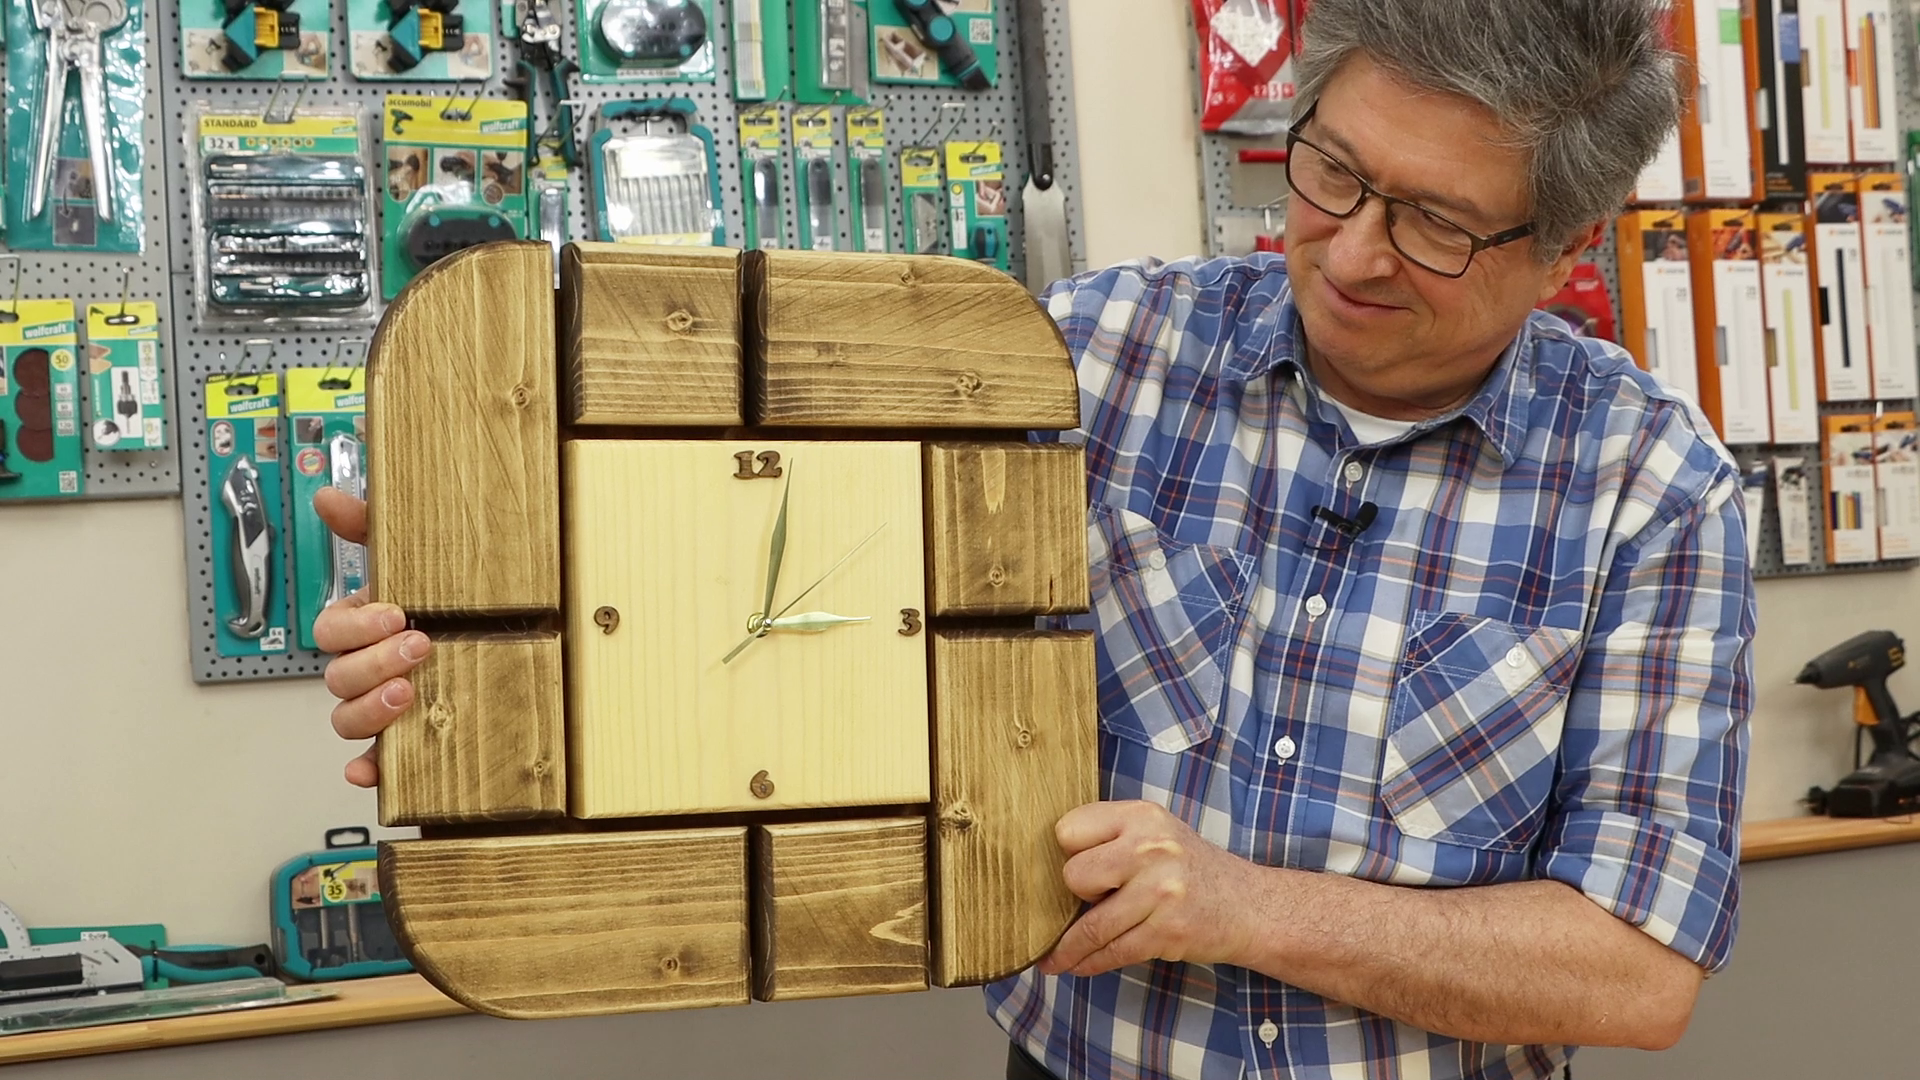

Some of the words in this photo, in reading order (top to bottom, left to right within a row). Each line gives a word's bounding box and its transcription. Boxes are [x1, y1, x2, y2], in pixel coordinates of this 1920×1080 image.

[387, 98, 432, 108] accumobil
[203, 119, 258, 128] STANDARD
[481, 119, 519, 133] wolfcraft
[209, 138, 224, 149] 32
[227, 140, 235, 149] x
[24, 323, 67, 339] wolfcraft
[54, 355, 69, 364] 50
[230, 397, 270, 413] wolfcraft
[732, 450, 783, 480] 12
[594, 605, 620, 635] 9
[897, 608, 922, 637] 3
[750, 769, 775, 799] 6
[328, 884, 342, 896] 35
